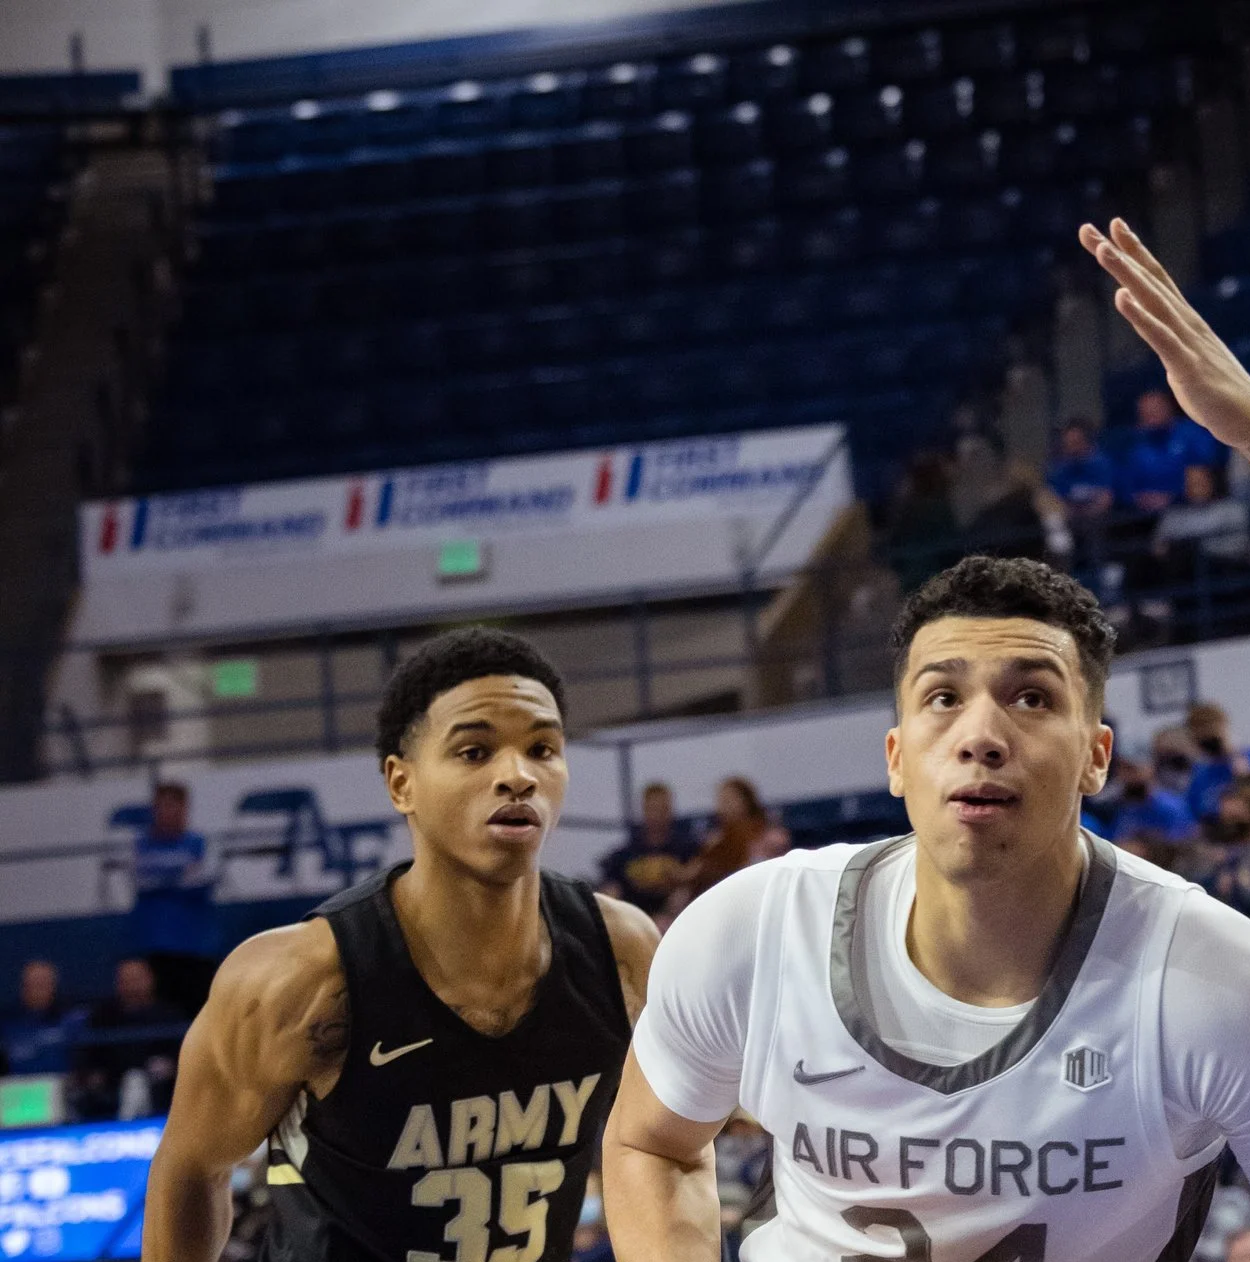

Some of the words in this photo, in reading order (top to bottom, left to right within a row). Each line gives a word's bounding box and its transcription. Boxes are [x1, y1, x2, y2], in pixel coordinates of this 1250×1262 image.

[386, 1073, 601, 1169] ARMY
[793, 1122, 880, 1184] AIR
[899, 1137, 1125, 1197] FORCE
